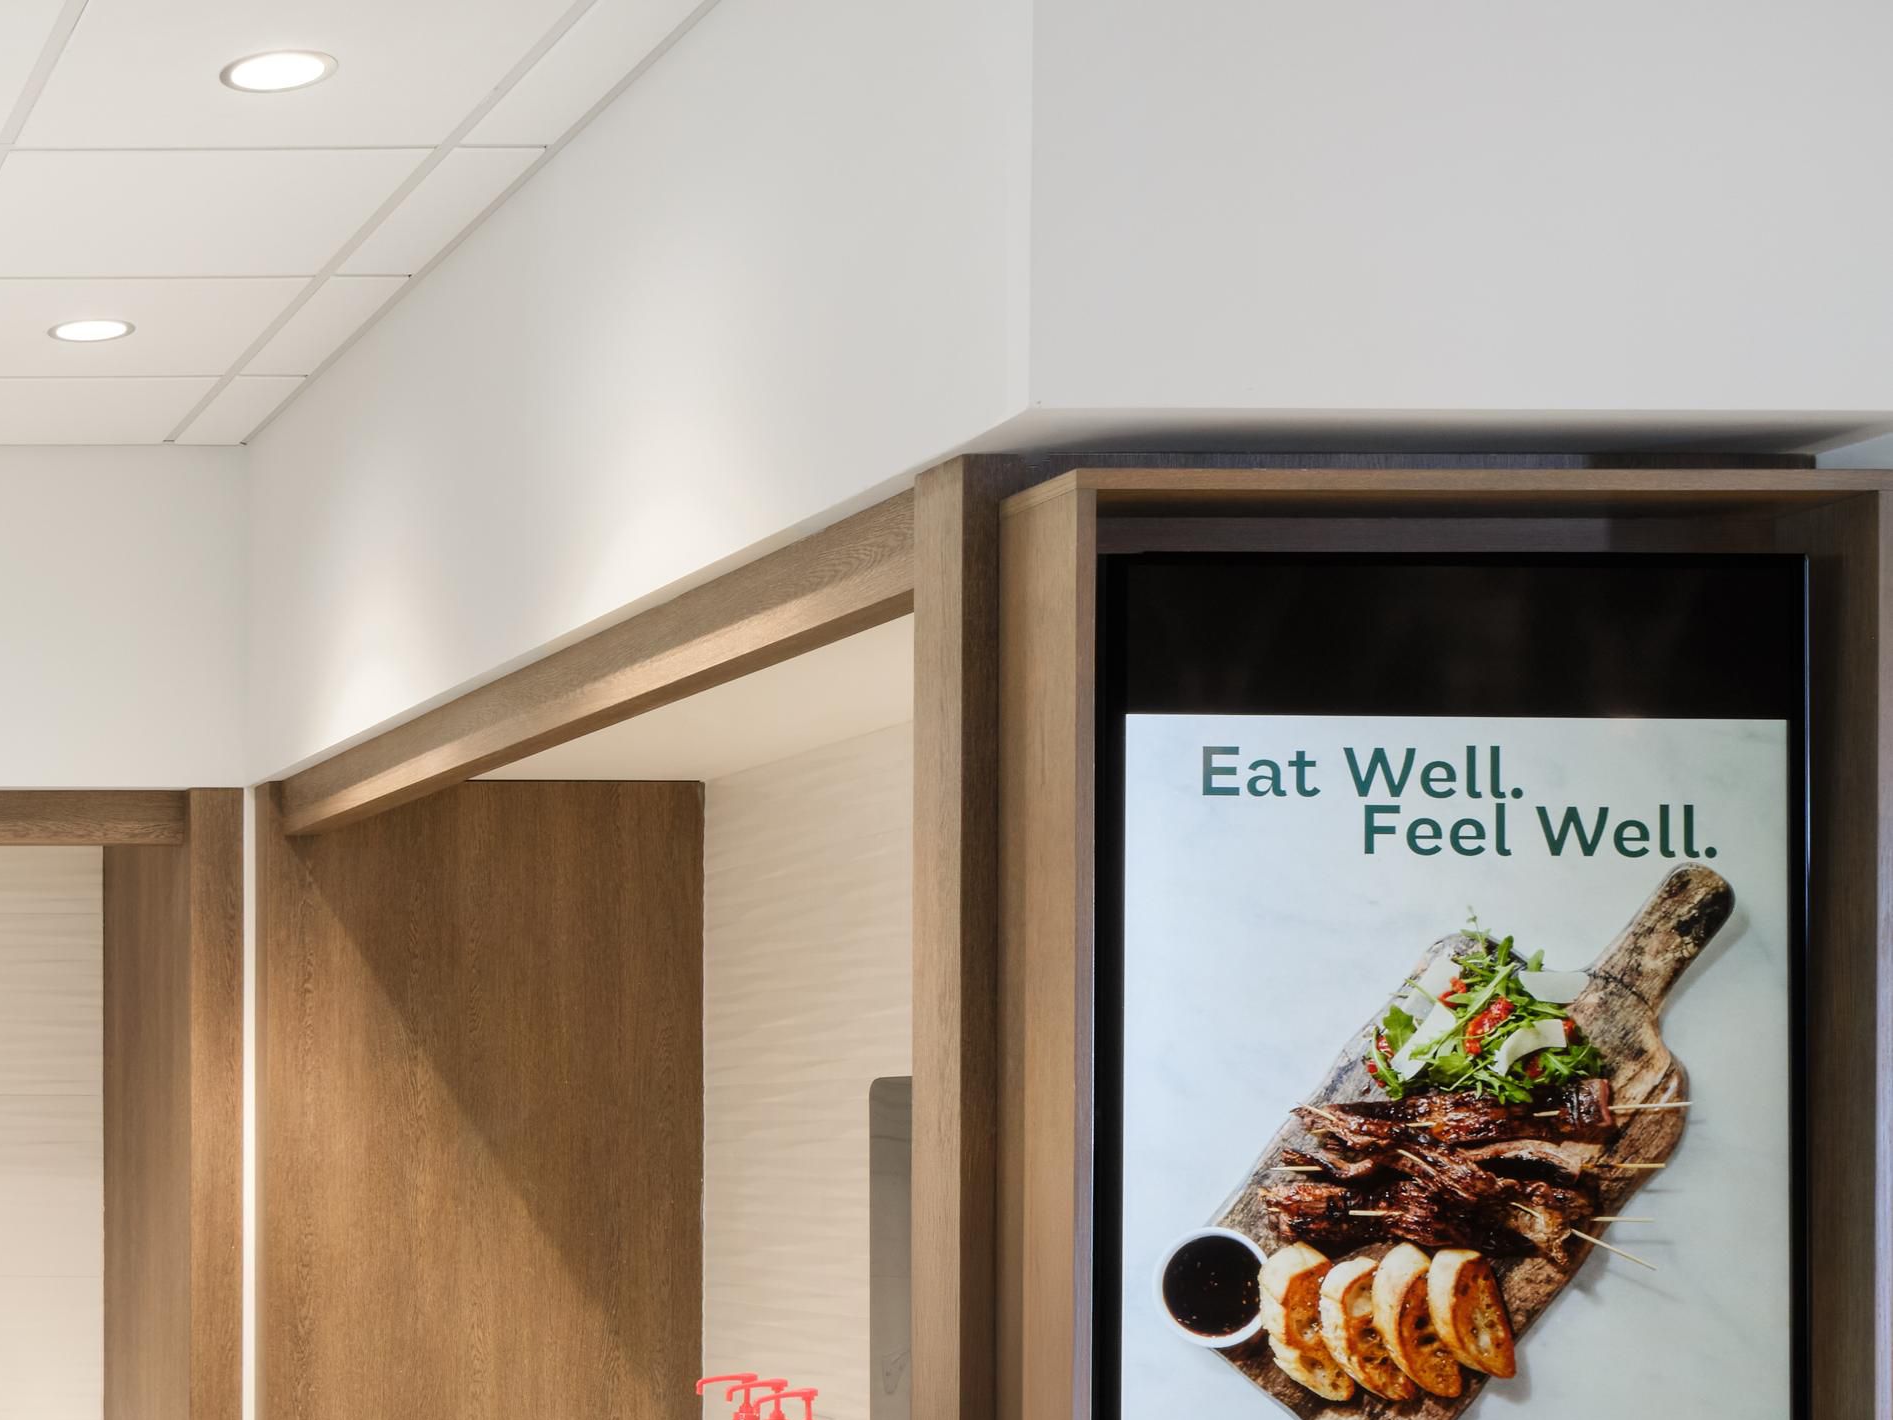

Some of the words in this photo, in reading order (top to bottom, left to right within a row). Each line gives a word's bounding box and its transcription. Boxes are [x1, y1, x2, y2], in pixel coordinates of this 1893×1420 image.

[1202, 745, 1321, 798] Eat
[1343, 745, 1524, 799] Well.
[1363, 803, 1512, 857] Feel
[1535, 804, 1718, 859] Well.
